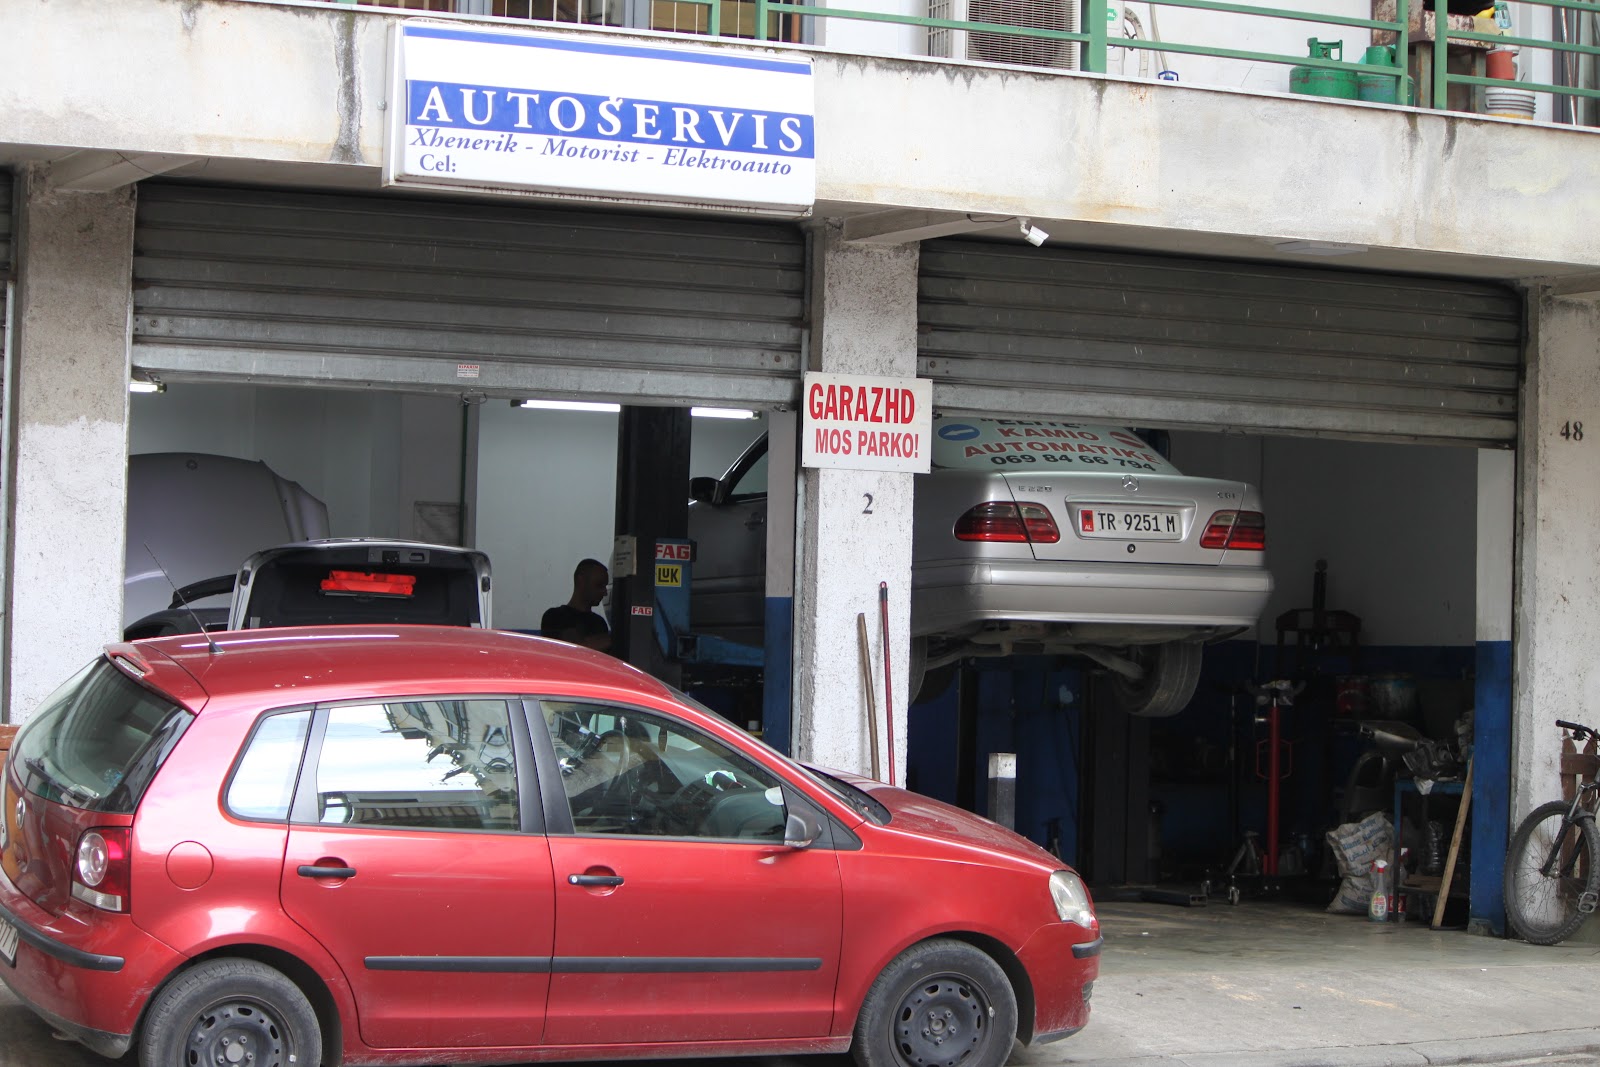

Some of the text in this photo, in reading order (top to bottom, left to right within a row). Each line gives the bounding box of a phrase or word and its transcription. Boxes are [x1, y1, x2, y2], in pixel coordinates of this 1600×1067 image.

[408, 128, 518, 153] Xhenerik
[540, 138, 640, 162] Motorist
[662, 147, 792, 175] Elektroauto
[419, 154, 457, 172] Cel:
[809, 383, 915, 425] GARAZHD
[996, 427, 1099, 441] KAMIO
[1560, 420, 1584, 441] 48
[815, 428, 919, 459] MOS PARKO!
[964, 441, 1161, 465] AUTOMATIKE
[990, 454, 1157, 472] 069 84 66 794
[862, 492, 874, 515] 2
[1097, 512, 1175, 533] TR 9251 M
[655, 544, 690, 560] FAG
[632, 606, 652, 615] FAG
